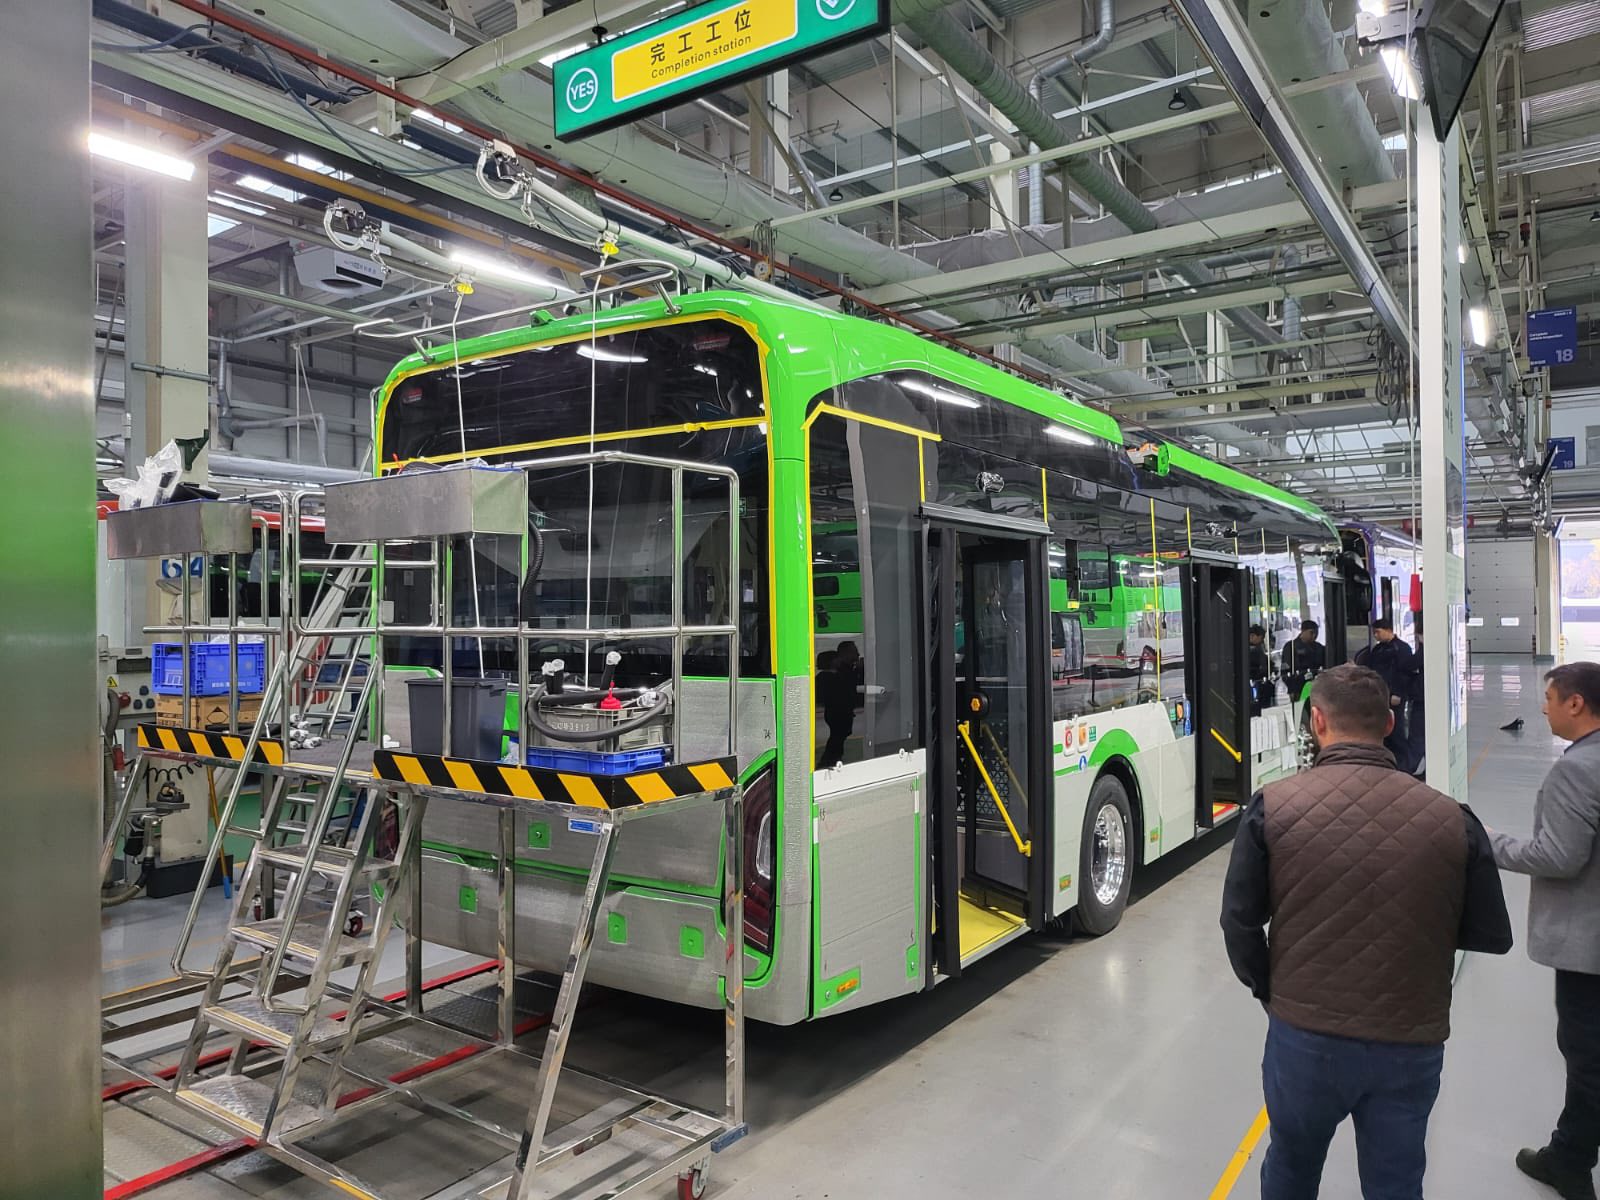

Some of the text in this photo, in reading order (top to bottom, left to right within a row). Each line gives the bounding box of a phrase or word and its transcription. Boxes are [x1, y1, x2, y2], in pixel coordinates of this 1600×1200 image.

[650, 9, 751, 66] 完工工位
[651, 35, 751, 79] Completion station
[571, 80, 594, 100] YES
[1555, 348, 1573, 362] 18
[161, 556, 204, 578] 64
